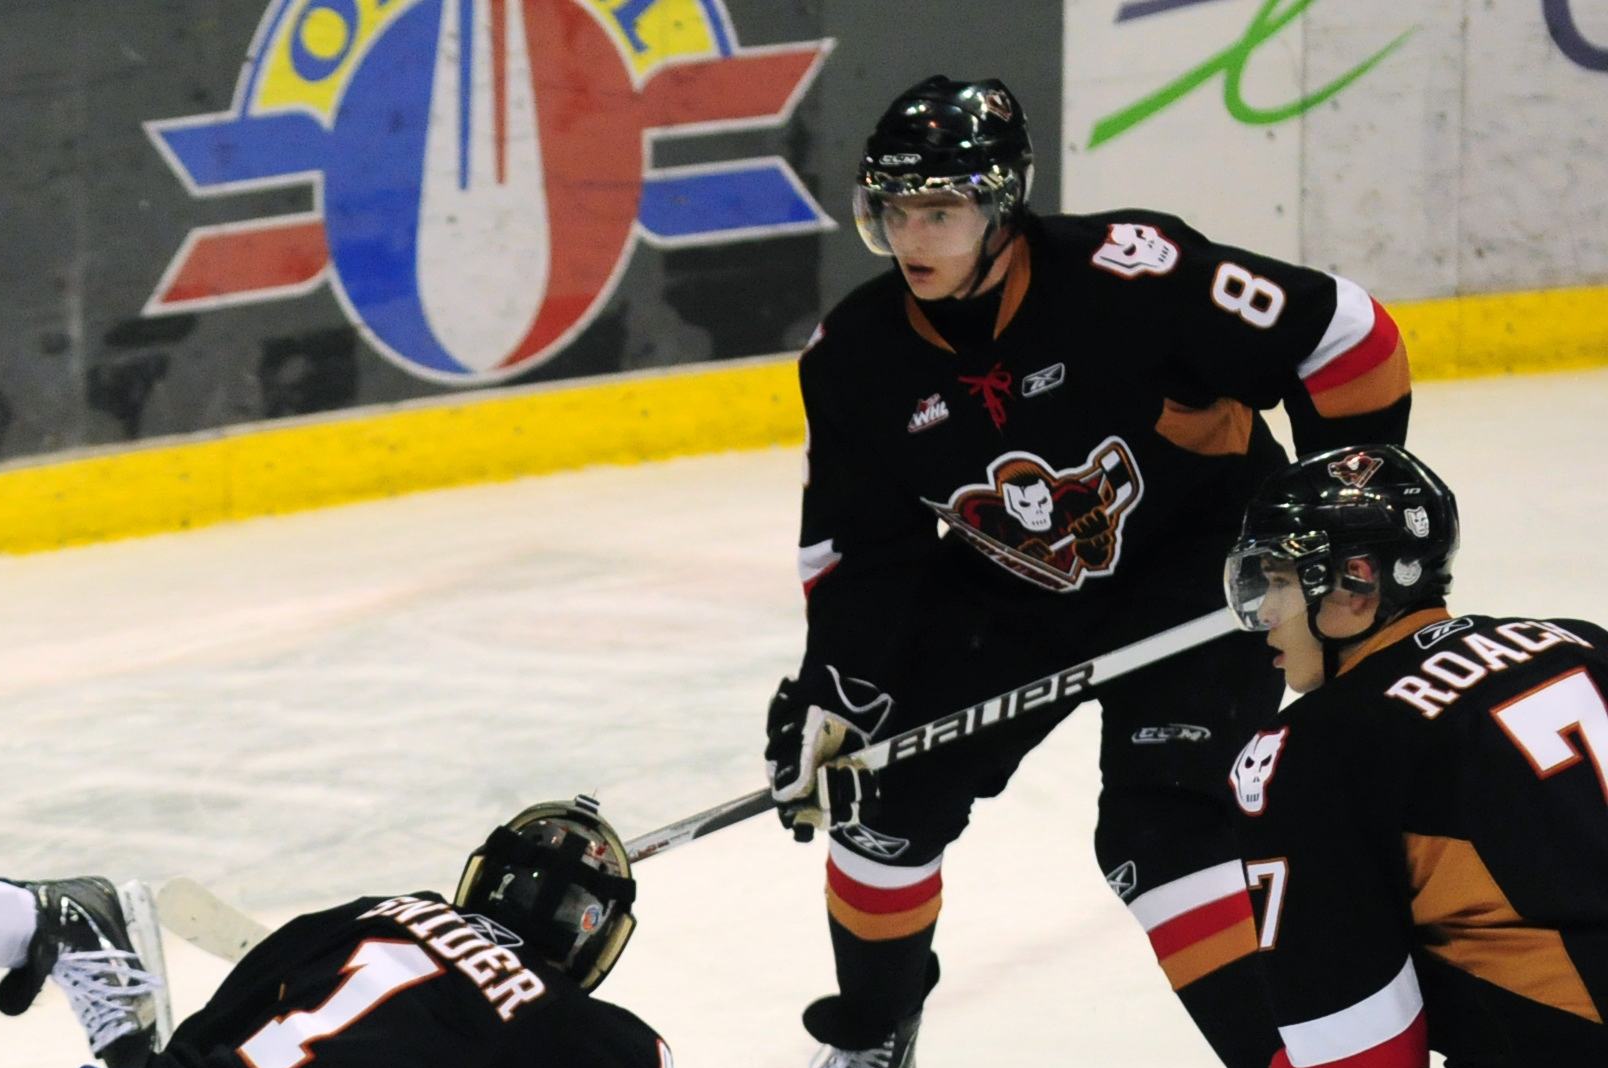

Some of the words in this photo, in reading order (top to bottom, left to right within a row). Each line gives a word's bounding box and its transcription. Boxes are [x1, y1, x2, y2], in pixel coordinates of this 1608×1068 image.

[1210, 262, 1286, 328] 8
[912, 400, 950, 426] WHL
[1245, 856, 1289, 952] 7
